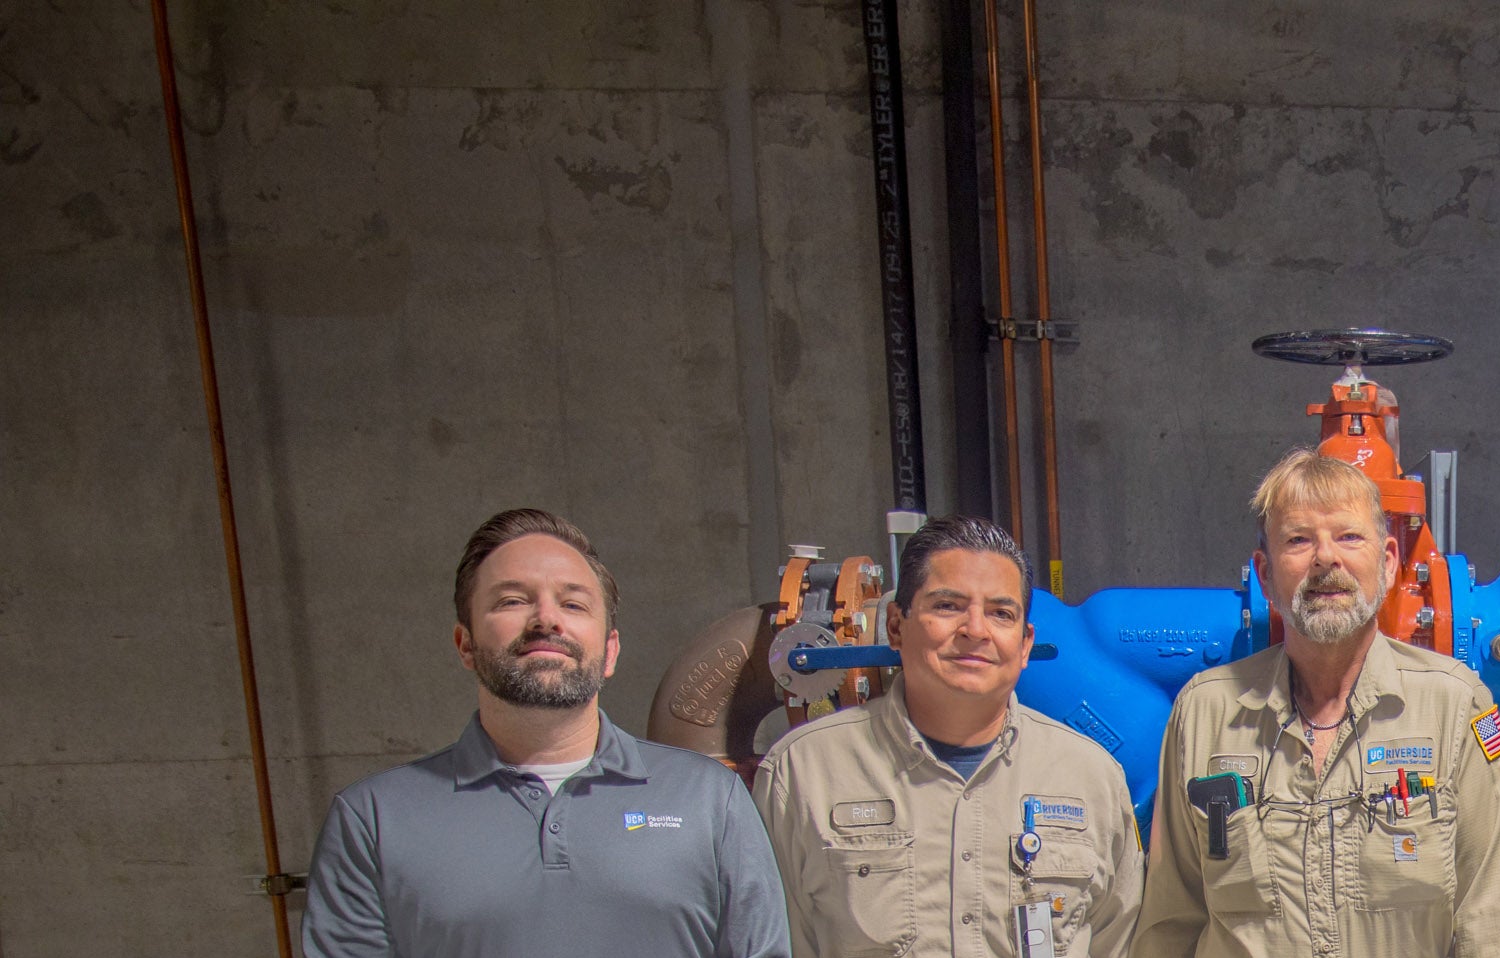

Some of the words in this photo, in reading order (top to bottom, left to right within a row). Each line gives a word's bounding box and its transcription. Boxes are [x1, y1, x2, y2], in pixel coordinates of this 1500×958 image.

[1385, 747, 1433, 759] RIVERSIDE
[1219, 759, 1248, 770] Chris
[852, 806, 878, 818] Rich
[1042, 804, 1085, 818] RIVERSIDE
[626, 815, 644, 825] UCR
[647, 815, 684, 823] Facilities
[648, 820, 681, 828] Services
